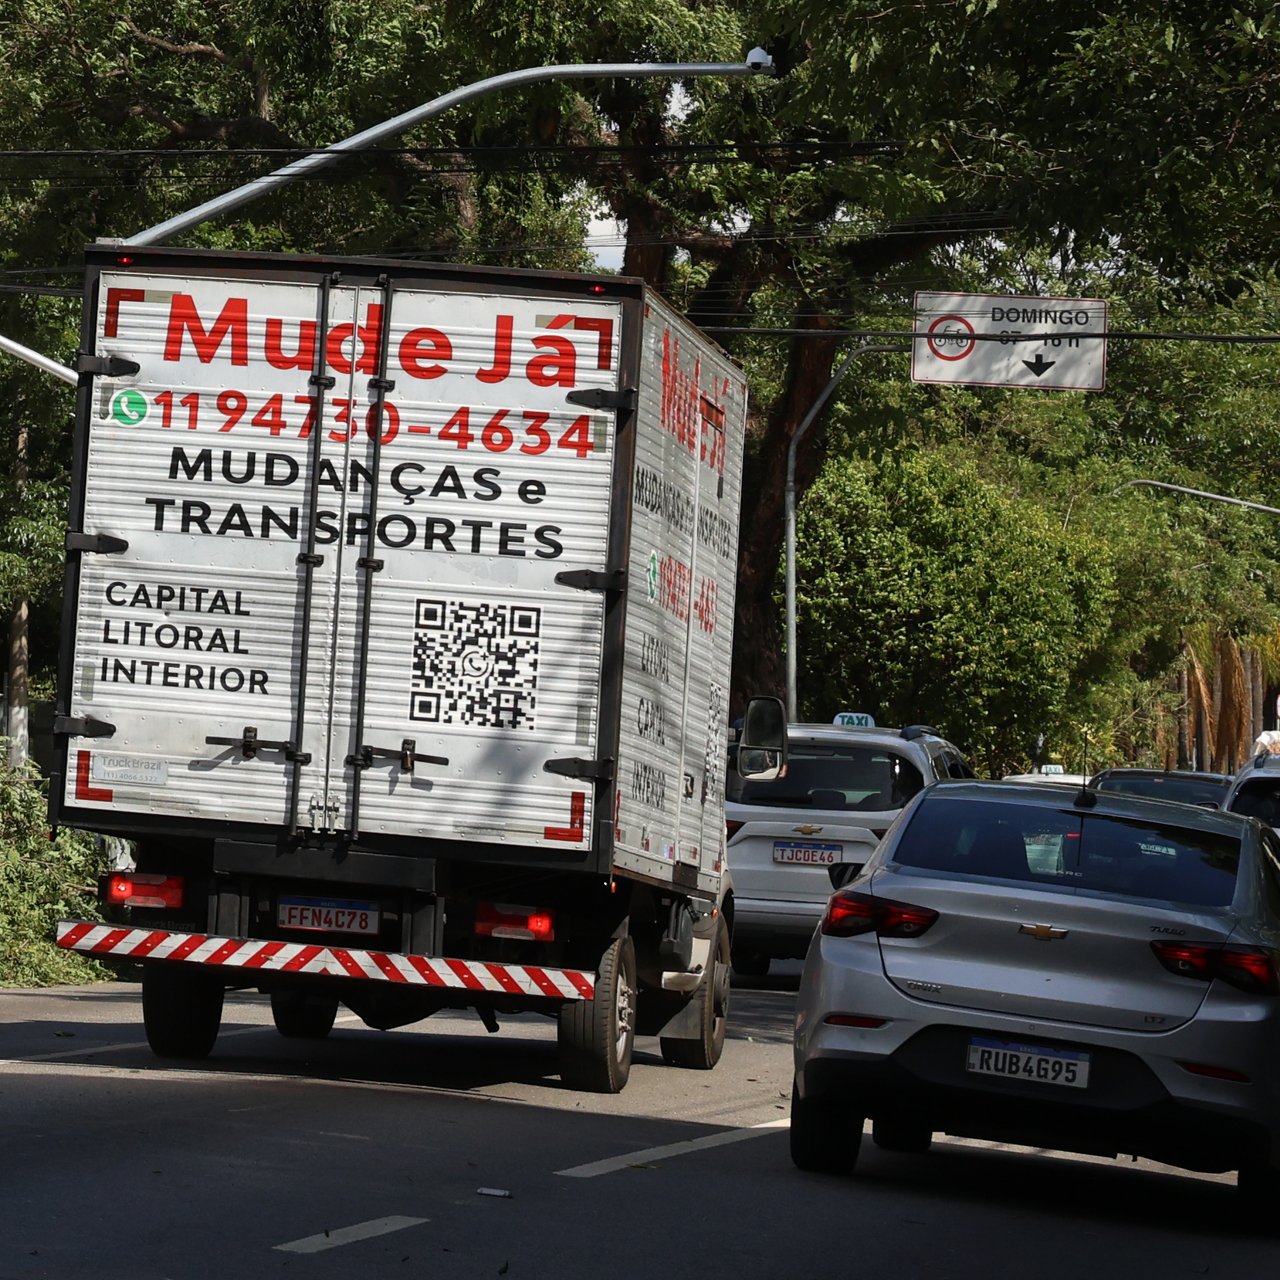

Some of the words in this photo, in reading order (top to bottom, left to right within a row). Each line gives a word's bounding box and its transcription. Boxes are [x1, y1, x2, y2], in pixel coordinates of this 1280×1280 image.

[991, 307, 1090, 326] DOMINGO
[163, 293, 453, 380] Mude
[475, 313, 577, 388] Já
[168, 446, 503, 505] MUDANÇAS
[517, 477, 547, 505] e
[145, 496, 564, 559] TRANSPORTES
[105, 581, 251, 616] CAPITAL
[102, 619, 249, 655] LITORAL
[100, 657, 269, 695] INTERIOR
[838, 714, 869, 727] TAXI
[287, 907, 369, 930] FFN4C78
[979, 1049, 1079, 1084] RUB4G95
